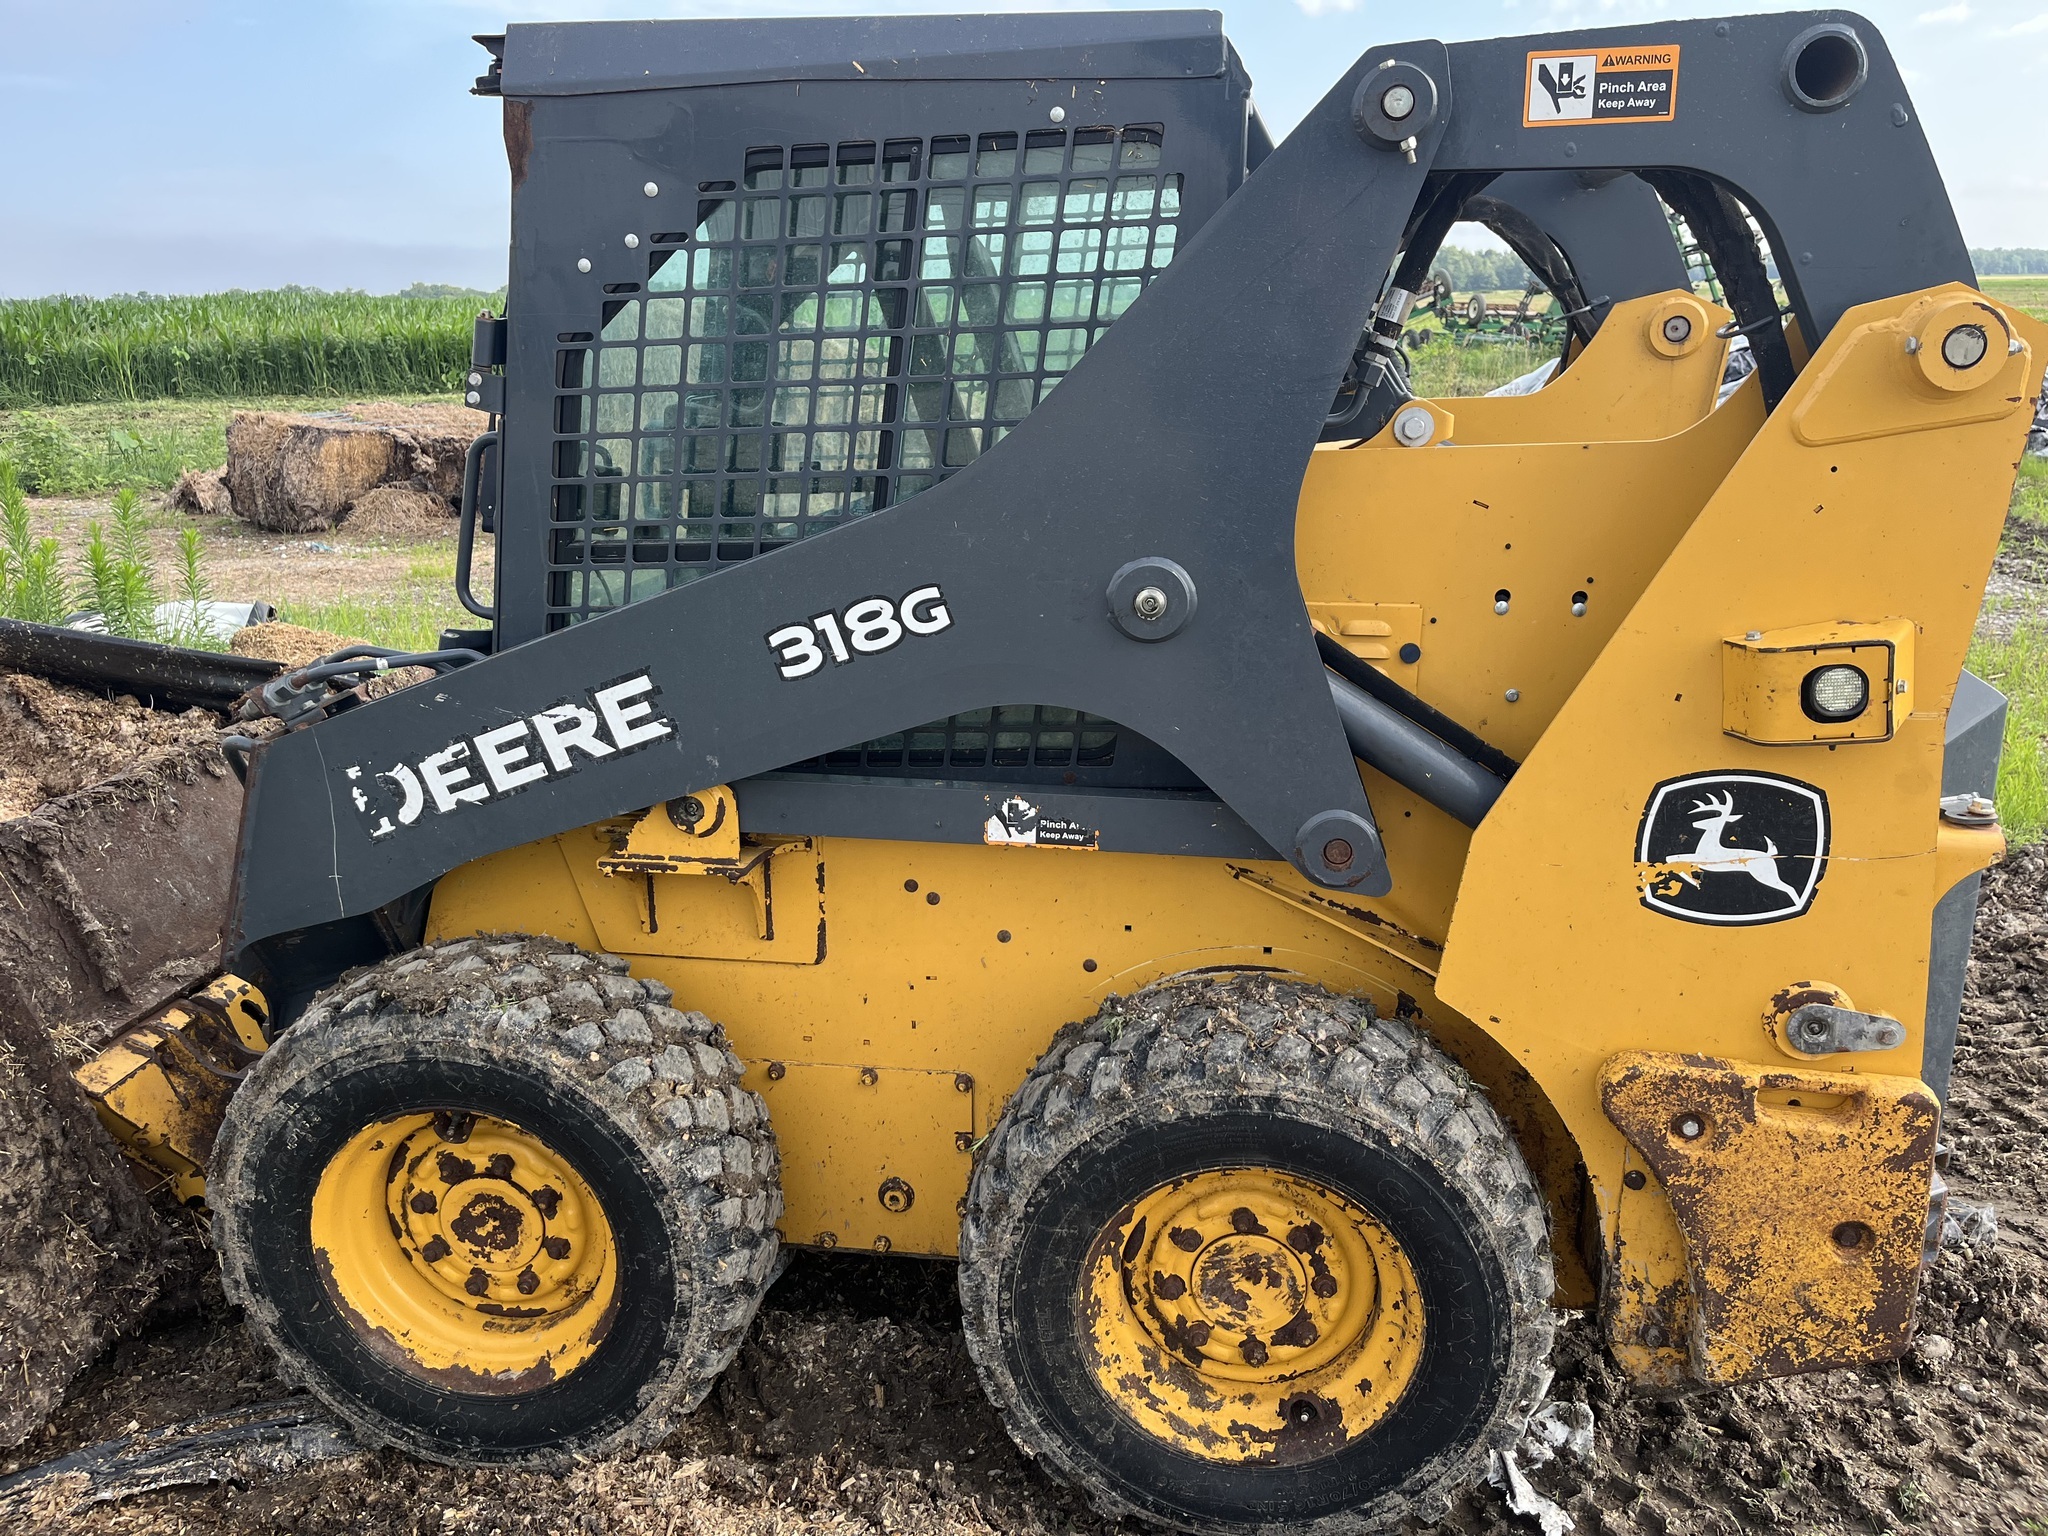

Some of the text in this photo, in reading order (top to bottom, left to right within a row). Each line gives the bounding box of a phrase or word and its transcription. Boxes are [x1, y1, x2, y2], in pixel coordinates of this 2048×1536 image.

[1615, 54, 1671, 66] WARNING
[1599, 80, 1667, 94] Pinch Area
[1598, 97, 1656, 110] Keep Away
[767, 586, 951, 679] 318G
[1040, 819, 1067, 830] Pinch
[1039, 830, 1085, 842] Keep Away
